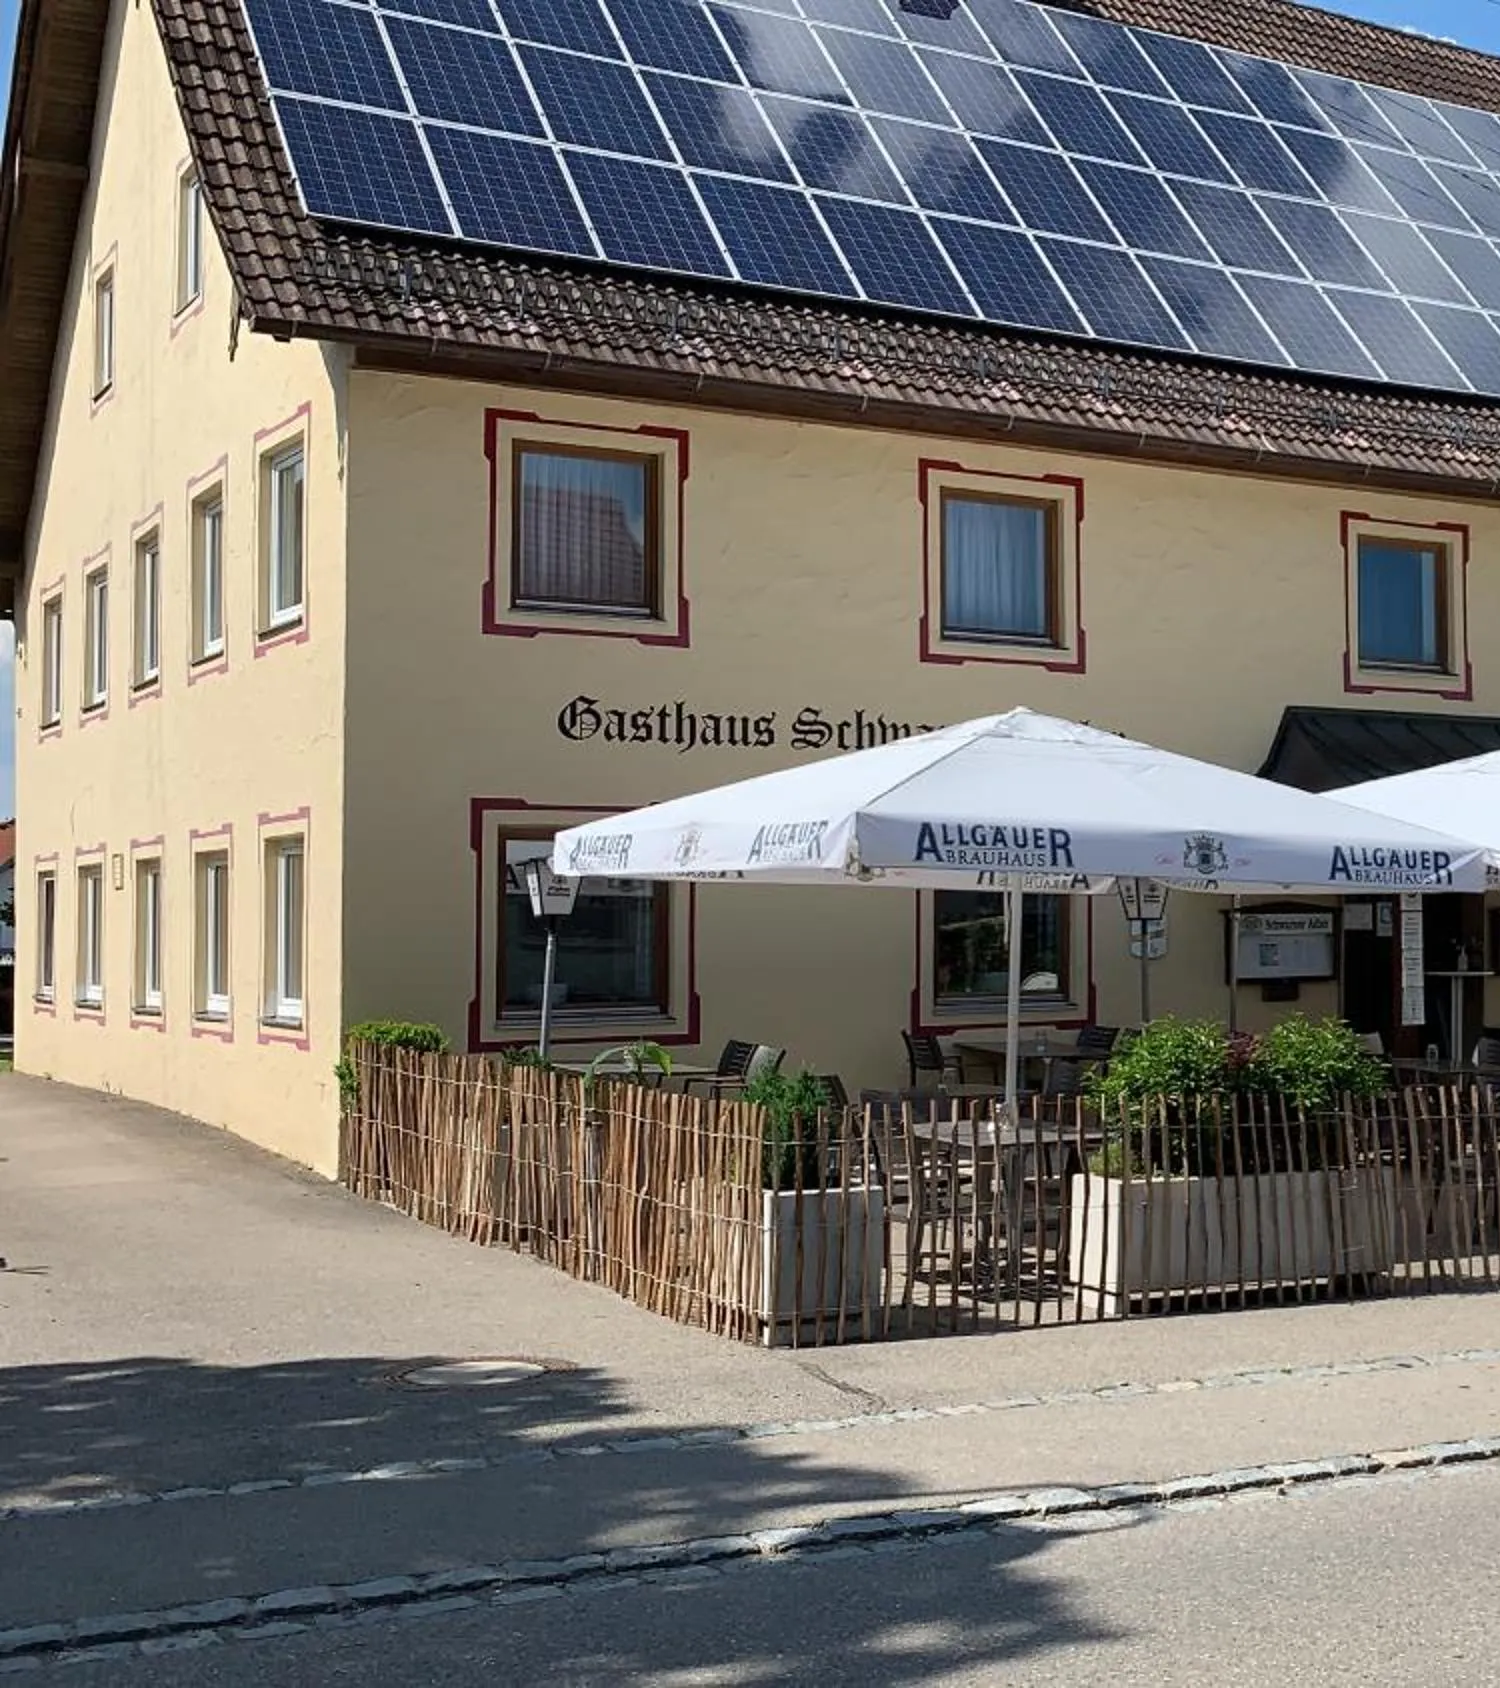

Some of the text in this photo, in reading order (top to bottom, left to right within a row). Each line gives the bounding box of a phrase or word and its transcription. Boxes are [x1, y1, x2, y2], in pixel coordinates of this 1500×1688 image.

[557, 695, 776, 755] Gasthaus
[914, 821, 1074, 868] ALLGÄUER
[947, 849, 1046, 867] BRAUHAUS
[1329, 845, 1453, 886] ALLGÄUER
